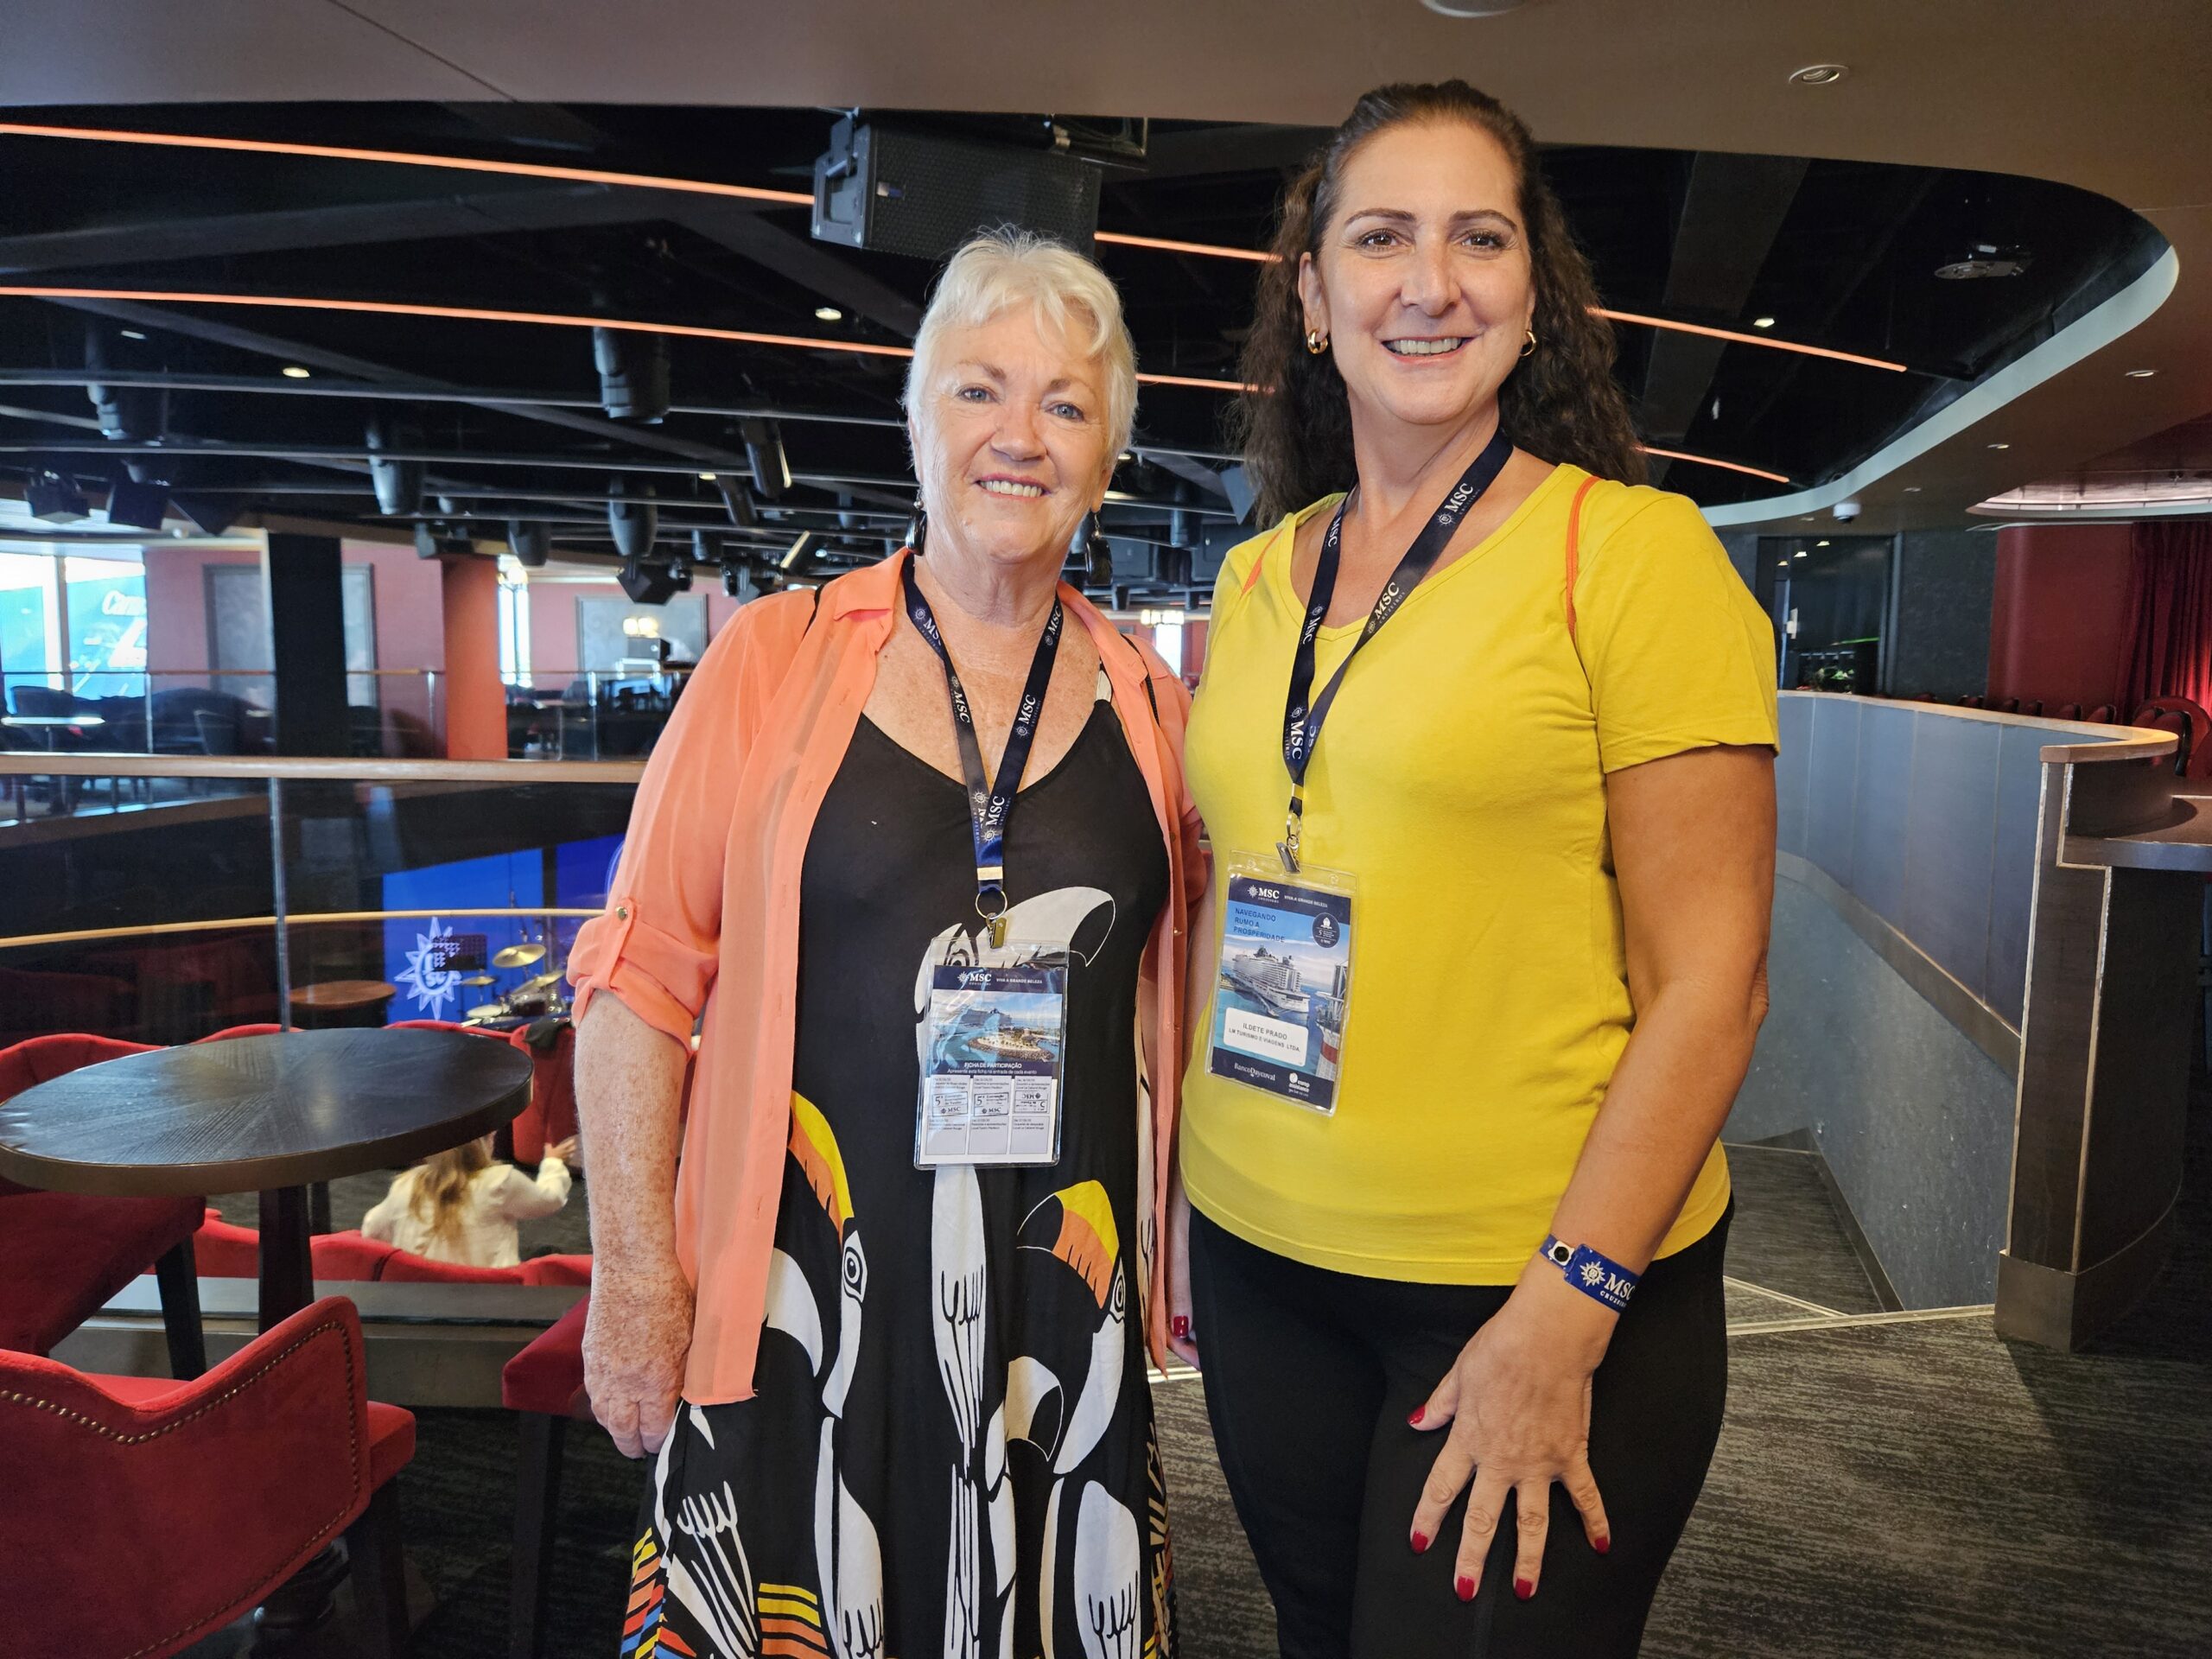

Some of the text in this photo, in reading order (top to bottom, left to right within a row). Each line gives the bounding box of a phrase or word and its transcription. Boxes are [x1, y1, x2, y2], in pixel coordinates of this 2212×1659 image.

[1445, 483, 1473, 512] MSC
[1327, 516, 1342, 548] MSC
[1375, 582, 1400, 620] MSC
[1048, 606, 1061, 635] MSC
[1302, 616, 1321, 645] MSC
[954, 690, 970, 723] MSC
[1018, 694, 1036, 725] MSC
[1291, 720, 1304, 760] MSC
[985, 796, 1005, 826] MSC
[1258, 887, 1280, 899] MSC
[1235, 908, 1276, 922] NAVEGANDO
[1235, 917, 1254, 926] RUMO
[1234, 925, 1285, 943] PROSPERIDADE
[969, 974, 991, 982] MSC
[1236, 1030, 1258, 1039] TURISMO
[1243, 1023, 1287, 1040] ILDETE PRADO
[1604, 1272, 1636, 1300] MSC
